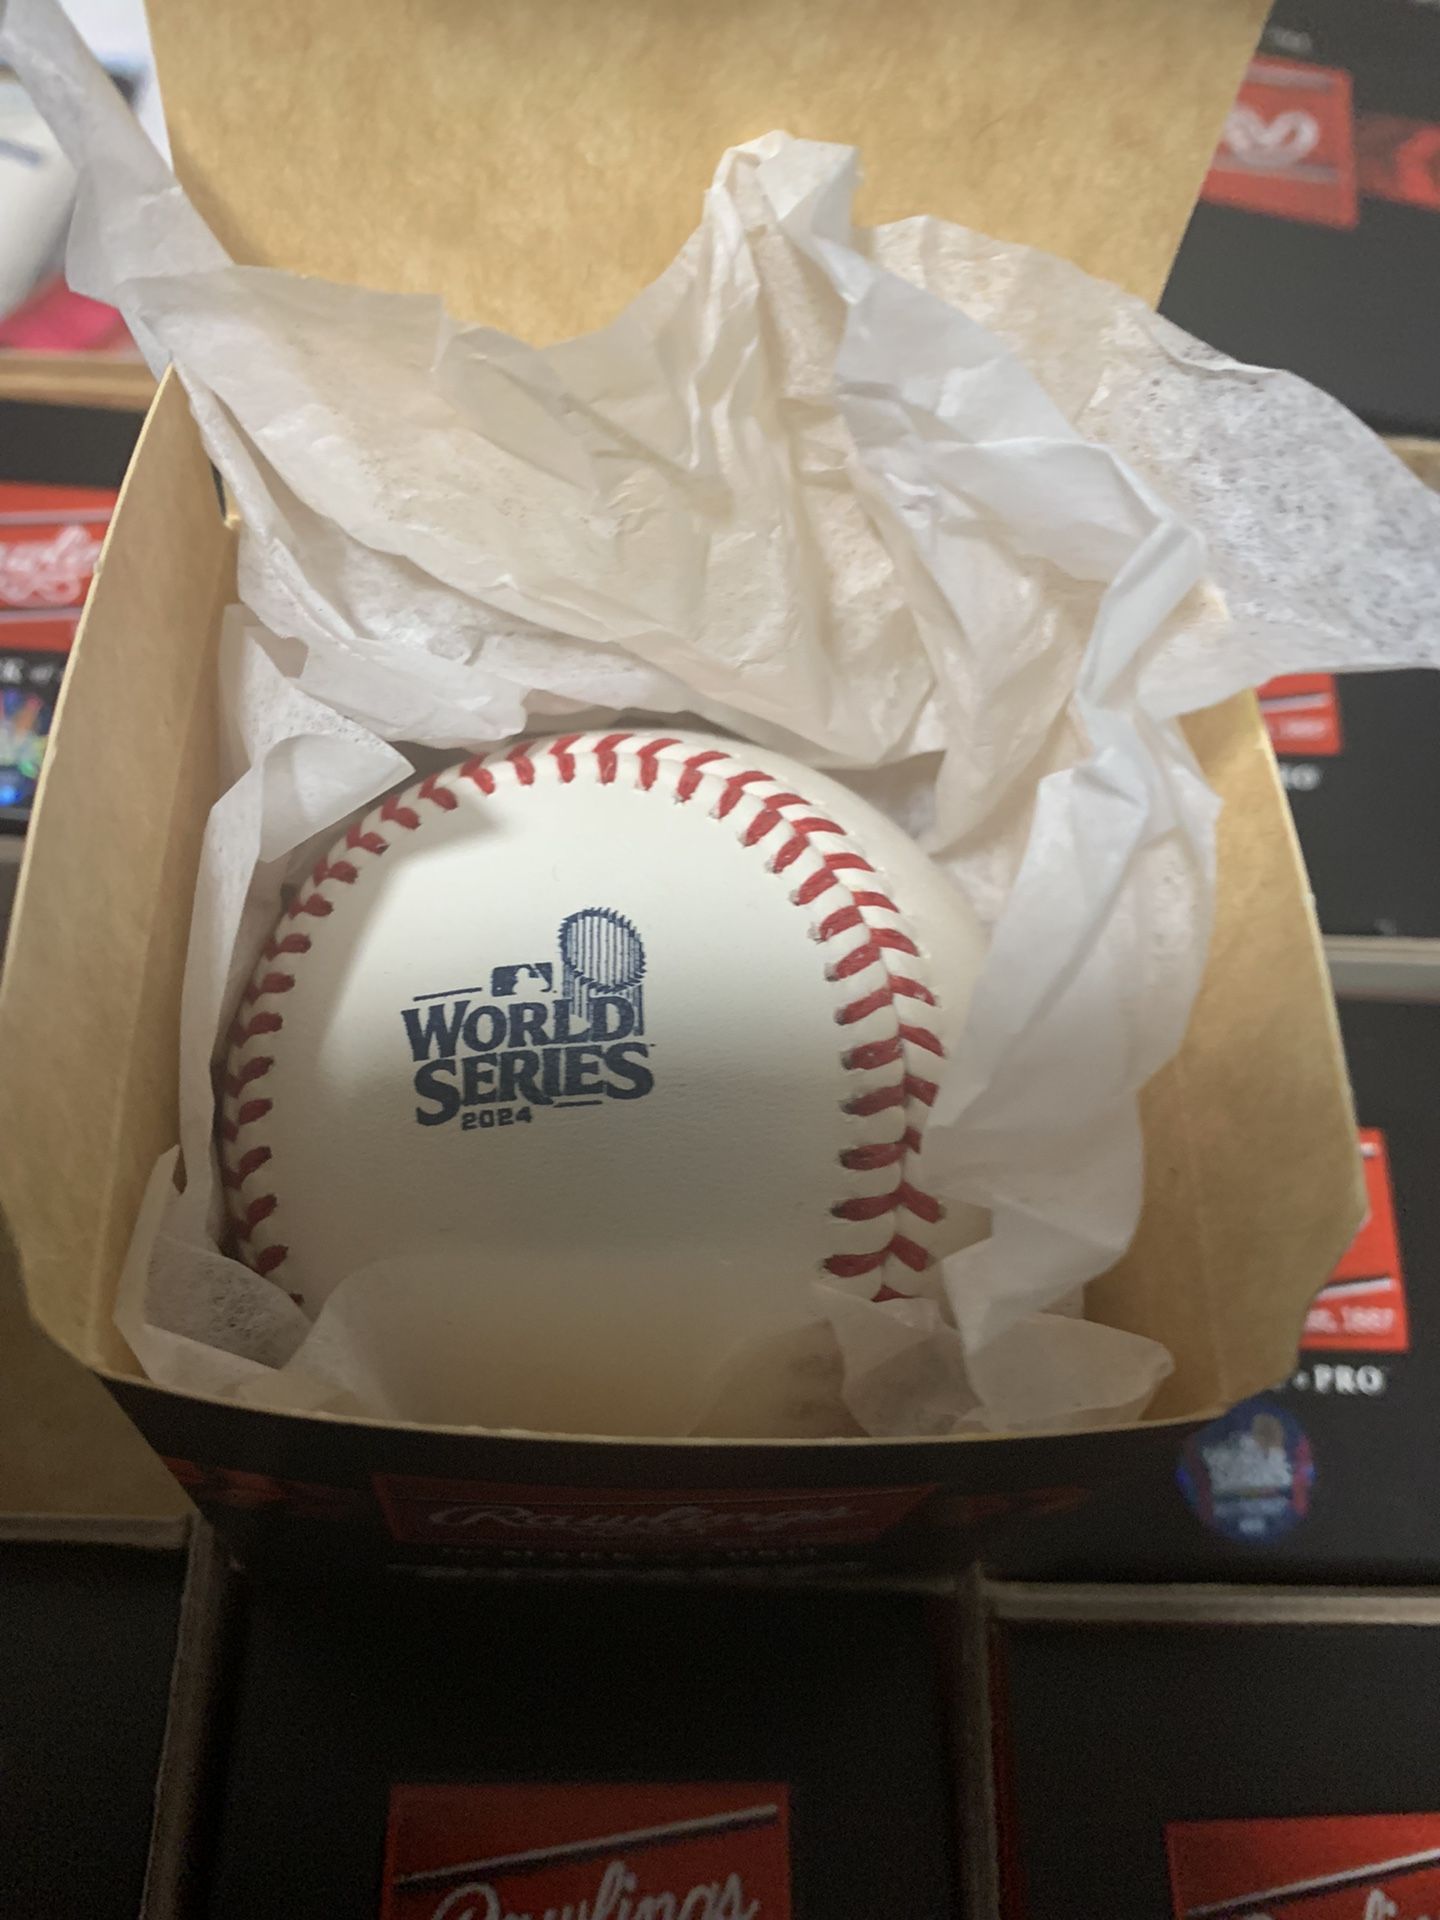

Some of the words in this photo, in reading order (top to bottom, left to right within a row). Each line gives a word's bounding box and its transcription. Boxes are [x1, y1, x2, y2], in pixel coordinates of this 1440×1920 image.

[401, 997, 635, 1062] WORLD
[413, 1042, 655, 1127] SERIES
[461, 1107, 533, 1131] 2024
[1313, 1363, 1385, 1397] PRO
